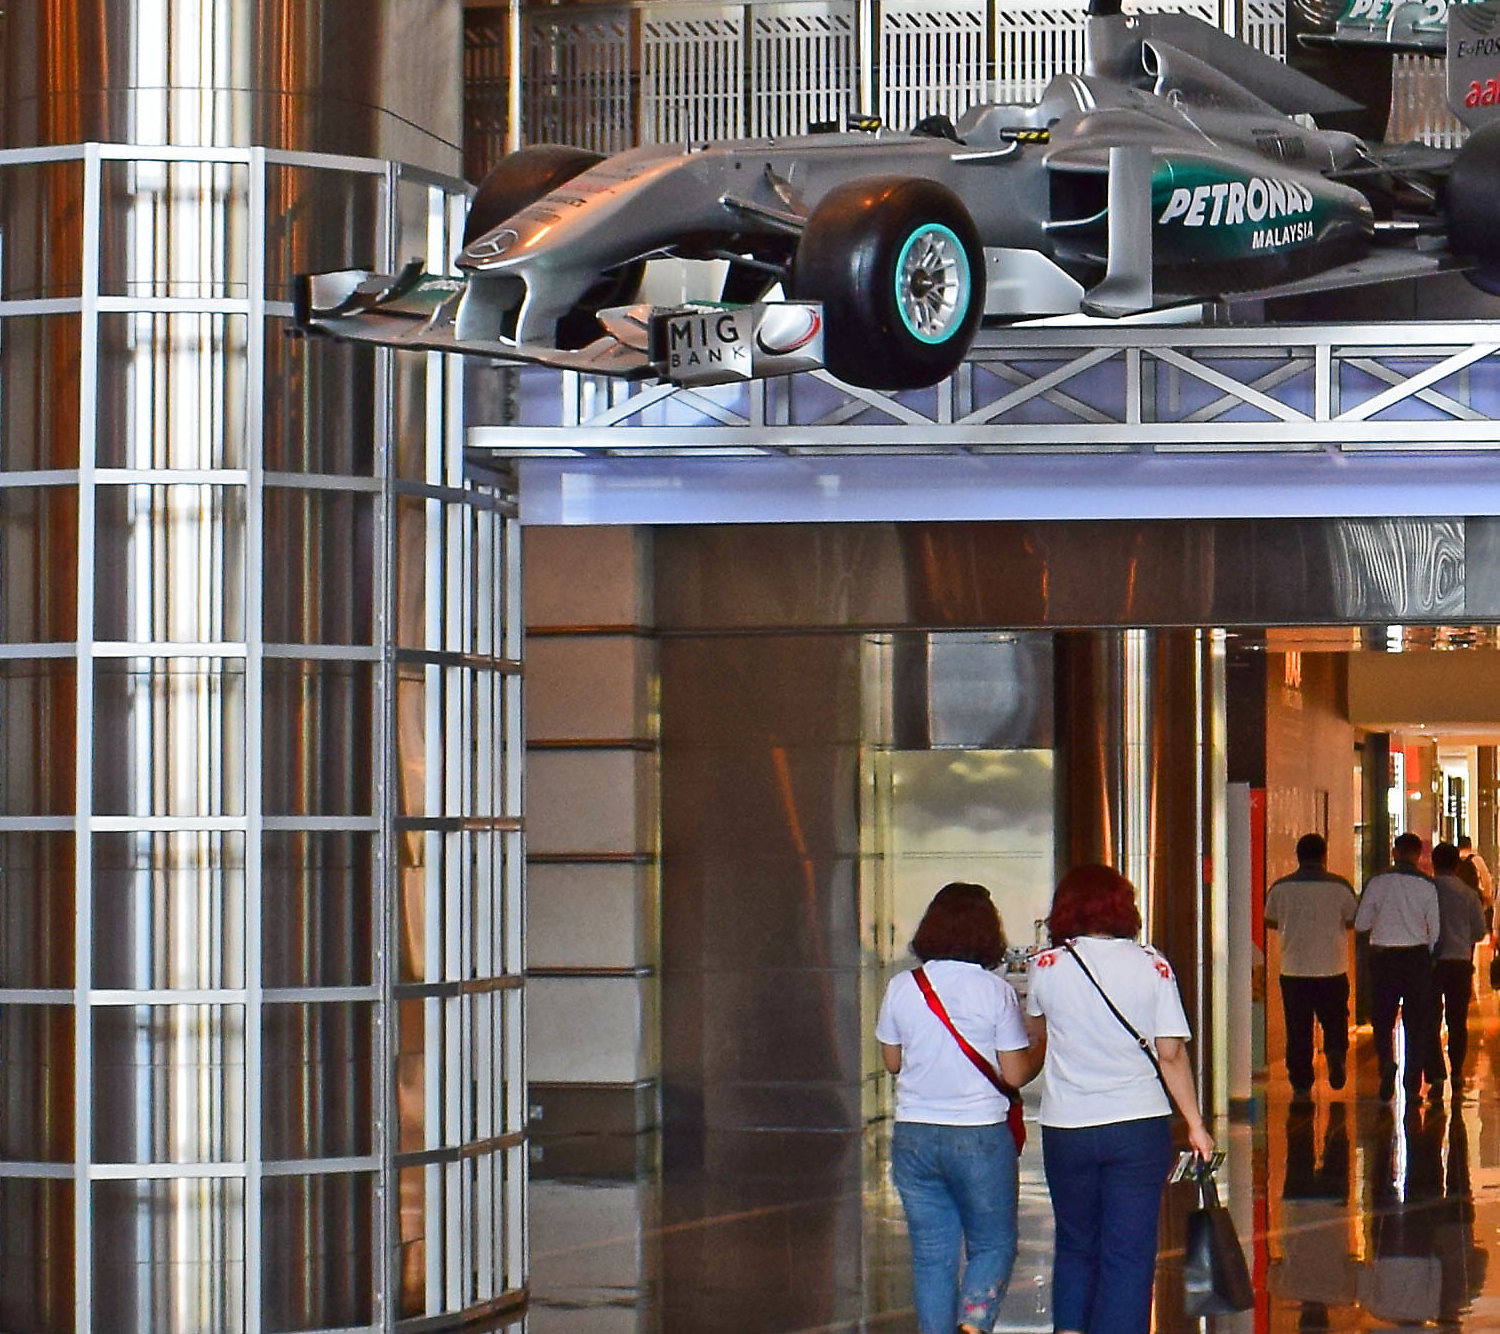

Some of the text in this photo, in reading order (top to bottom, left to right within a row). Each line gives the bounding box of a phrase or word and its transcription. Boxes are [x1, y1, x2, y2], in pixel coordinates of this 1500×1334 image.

[1158, 176, 1314, 227] PETRONAS
[1251, 220, 1315, 250] MALAYSIA
[670, 314, 740, 351] MIG
[671, 346, 747, 368] BANK
